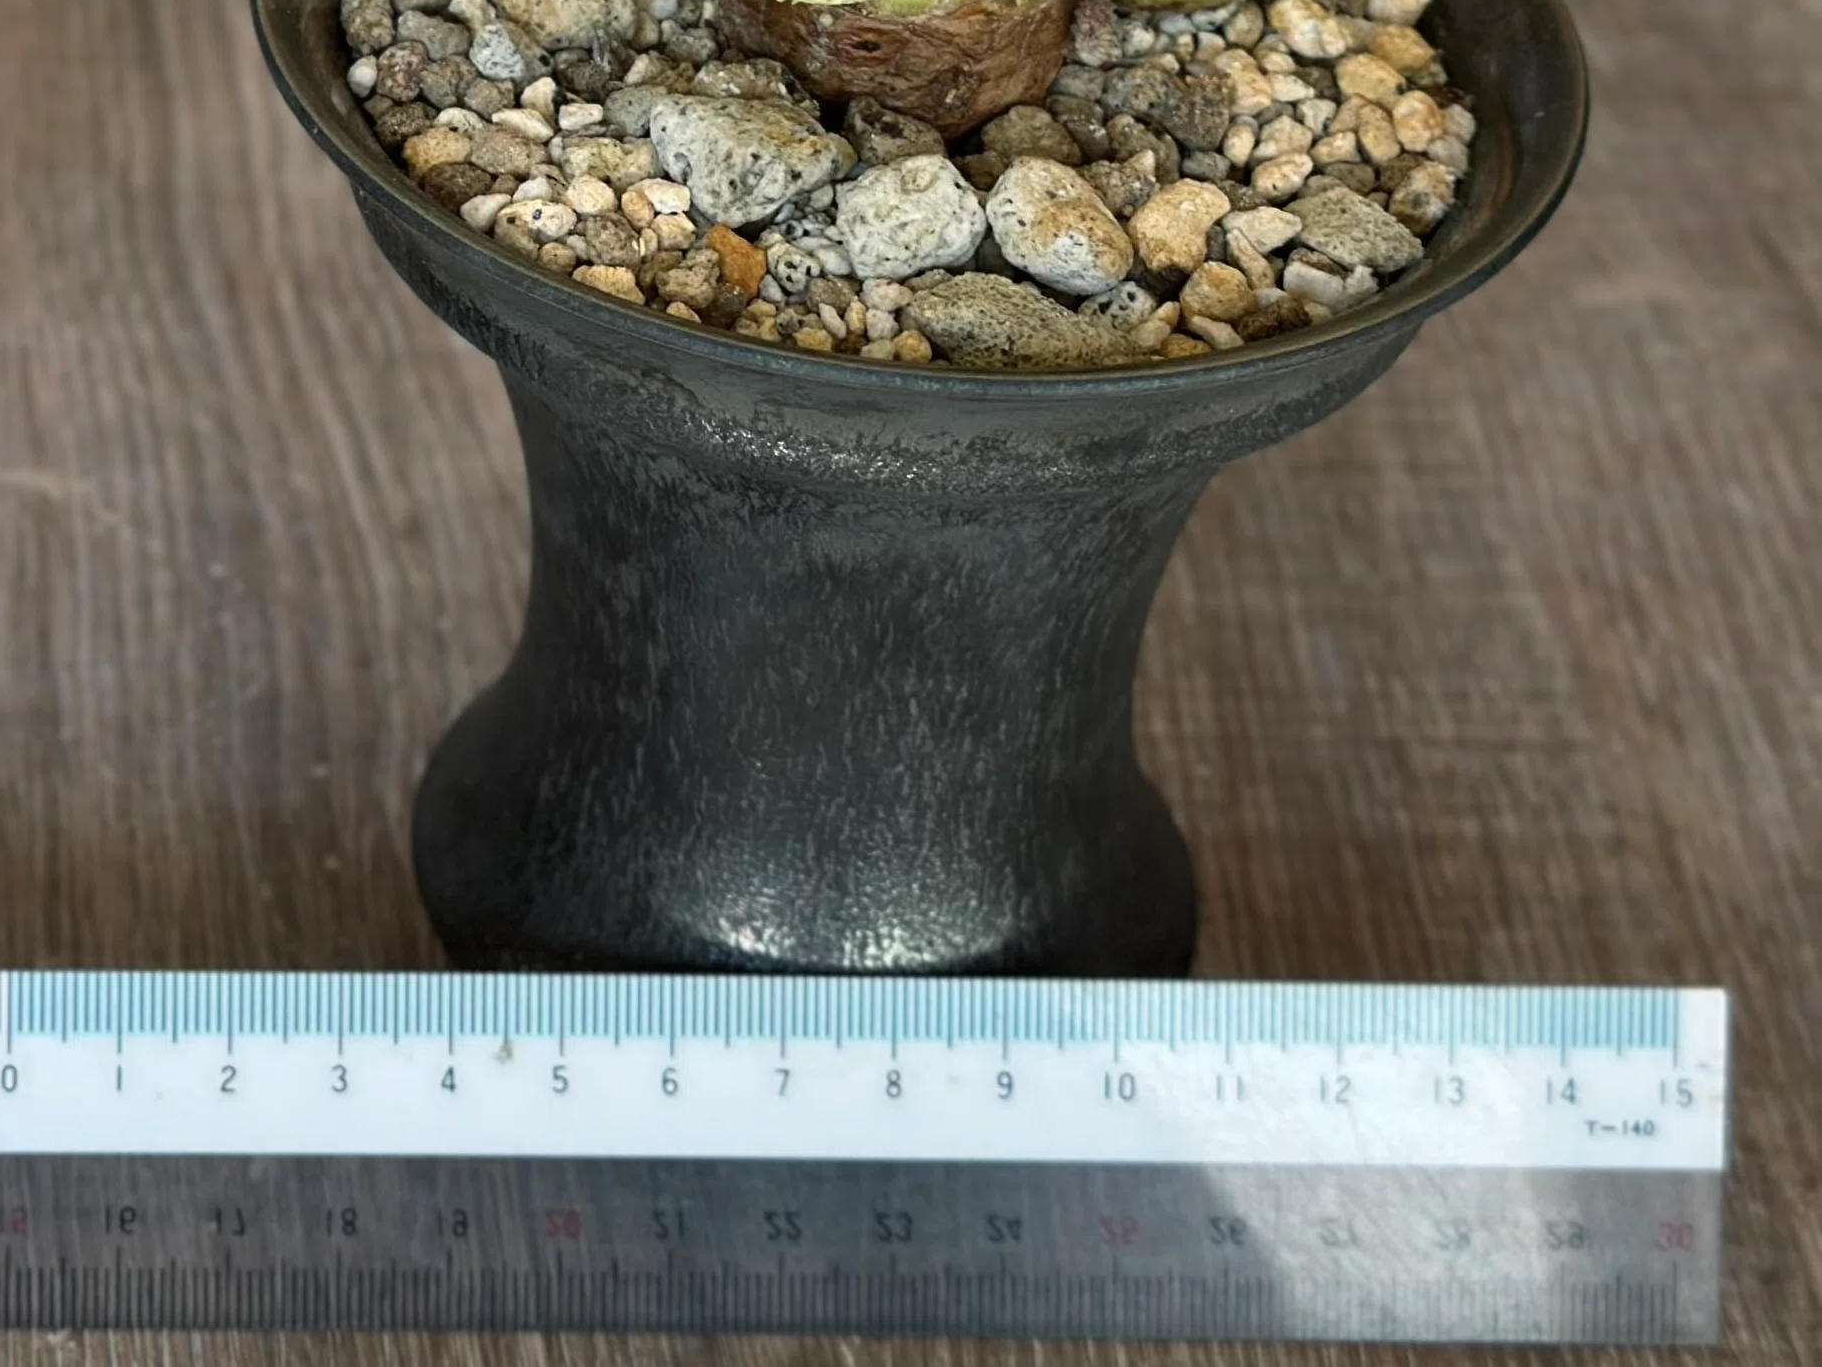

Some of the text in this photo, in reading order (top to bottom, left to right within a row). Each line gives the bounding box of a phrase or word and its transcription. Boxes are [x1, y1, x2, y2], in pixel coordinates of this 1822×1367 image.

[0, 1063, 19, 1094] 0
[115, 1065, 123, 1092] 1
[219, 1064, 238, 1095] 2
[331, 1063, 349, 1094] 3
[440, 1066, 457, 1093] 4
[552, 1064, 570, 1095] 5
[661, 1066, 679, 1097] 6
[775, 1067, 791, 1097] 7
[885, 1069, 902, 1099] 8
[996, 1070, 1015, 1101] 9
[1104, 1072, 1137, 1103] 10
[1215, 1074, 1246, 1102] 11
[1319, 1075, 1352, 1107] 12
[1434, 1075, 1467, 1108] 13
[1547, 1077, 1578, 1105] 14
[1659, 1078, 1694, 1108] 15
[1585, 1119, 1656, 1136] T-140
